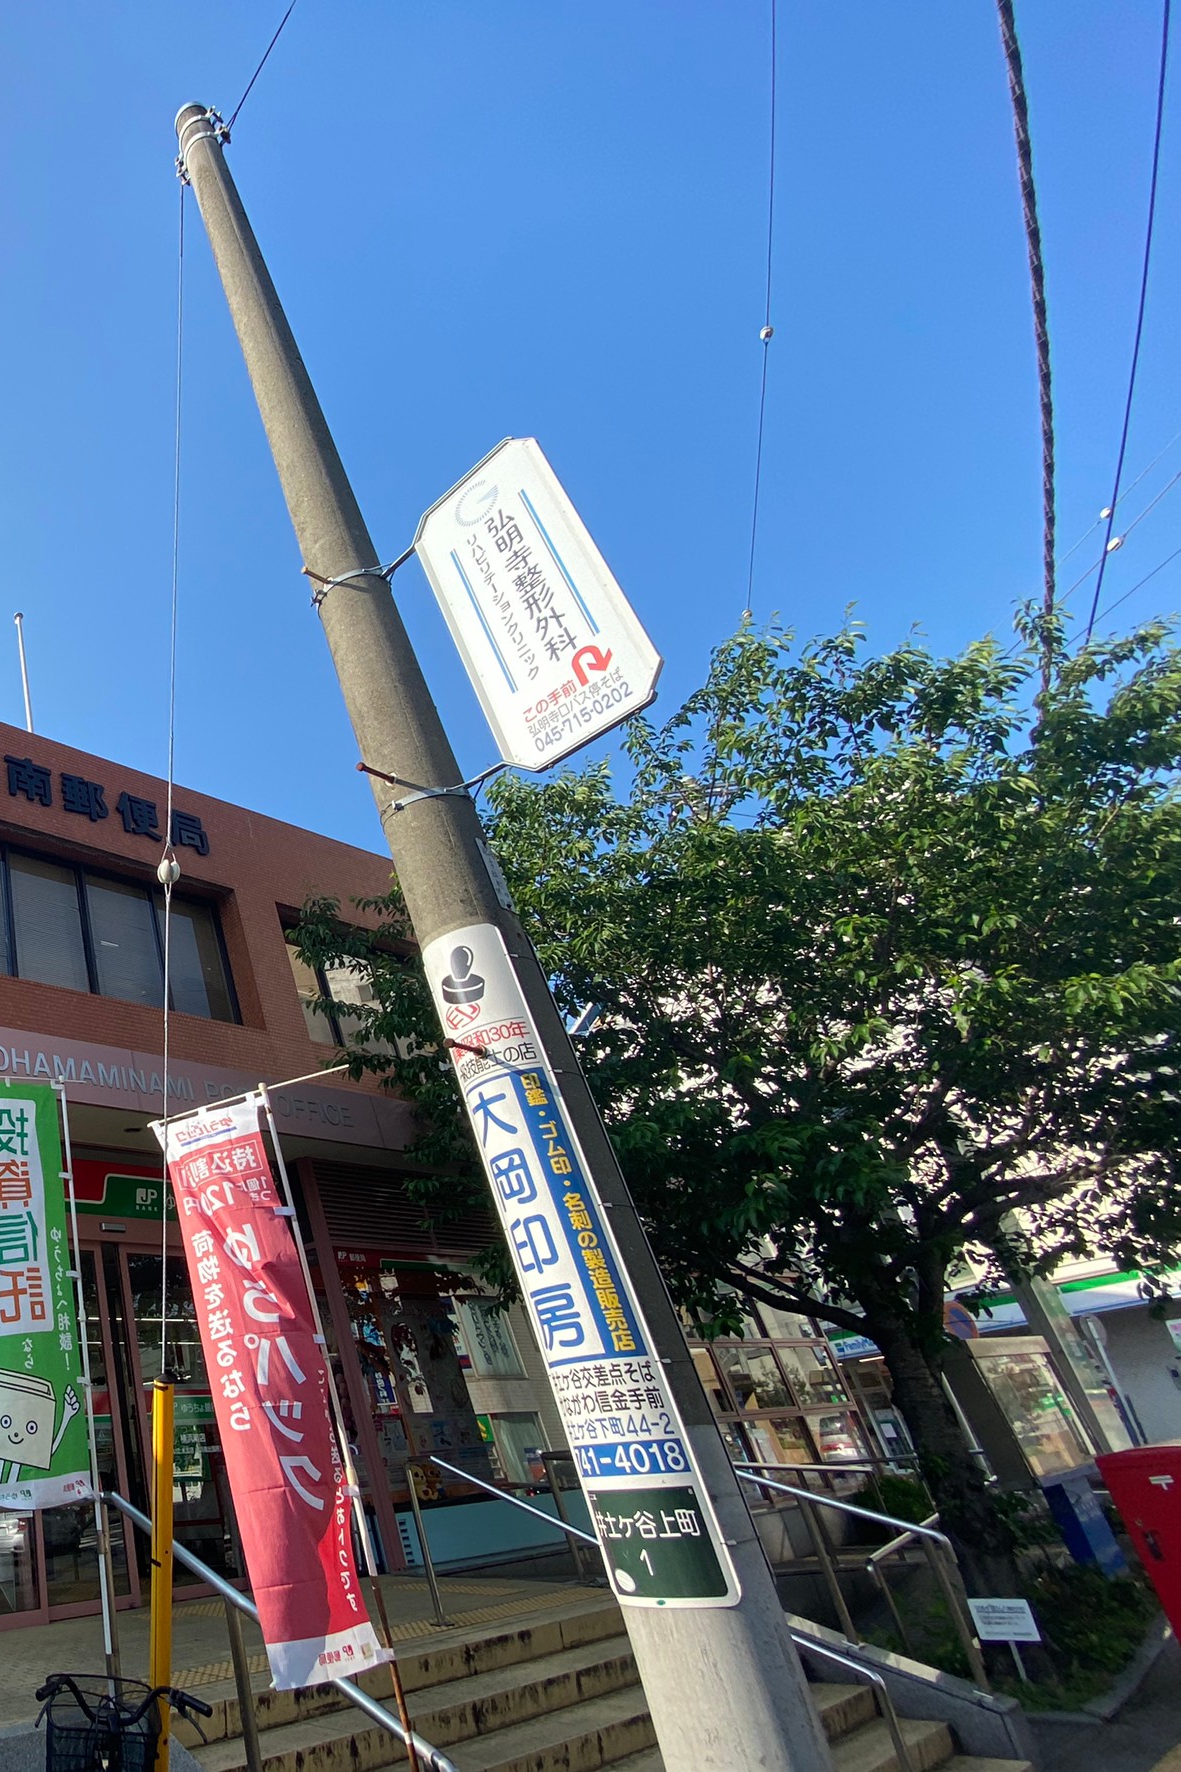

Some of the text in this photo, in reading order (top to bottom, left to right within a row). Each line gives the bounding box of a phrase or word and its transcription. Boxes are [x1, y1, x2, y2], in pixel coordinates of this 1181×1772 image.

[467, 534, 540, 681] リハビリテーションクリニック
[485, 509, 577, 662] 弘明寺整形外科
[522, 680, 577, 724] この手前
[527, 667, 624, 738] 弘明寺口バス停そば
[534, 681, 634, 753] 045-715-0202
[278, 1094, 355, 1128] OFFICE
[472, 1091, 585, 1351] 大岡印房
[521, 1072, 636, 1352] 印鑑・ゴム印・名刺の製造販売店
[640, 1548, 654, 1576] 1
